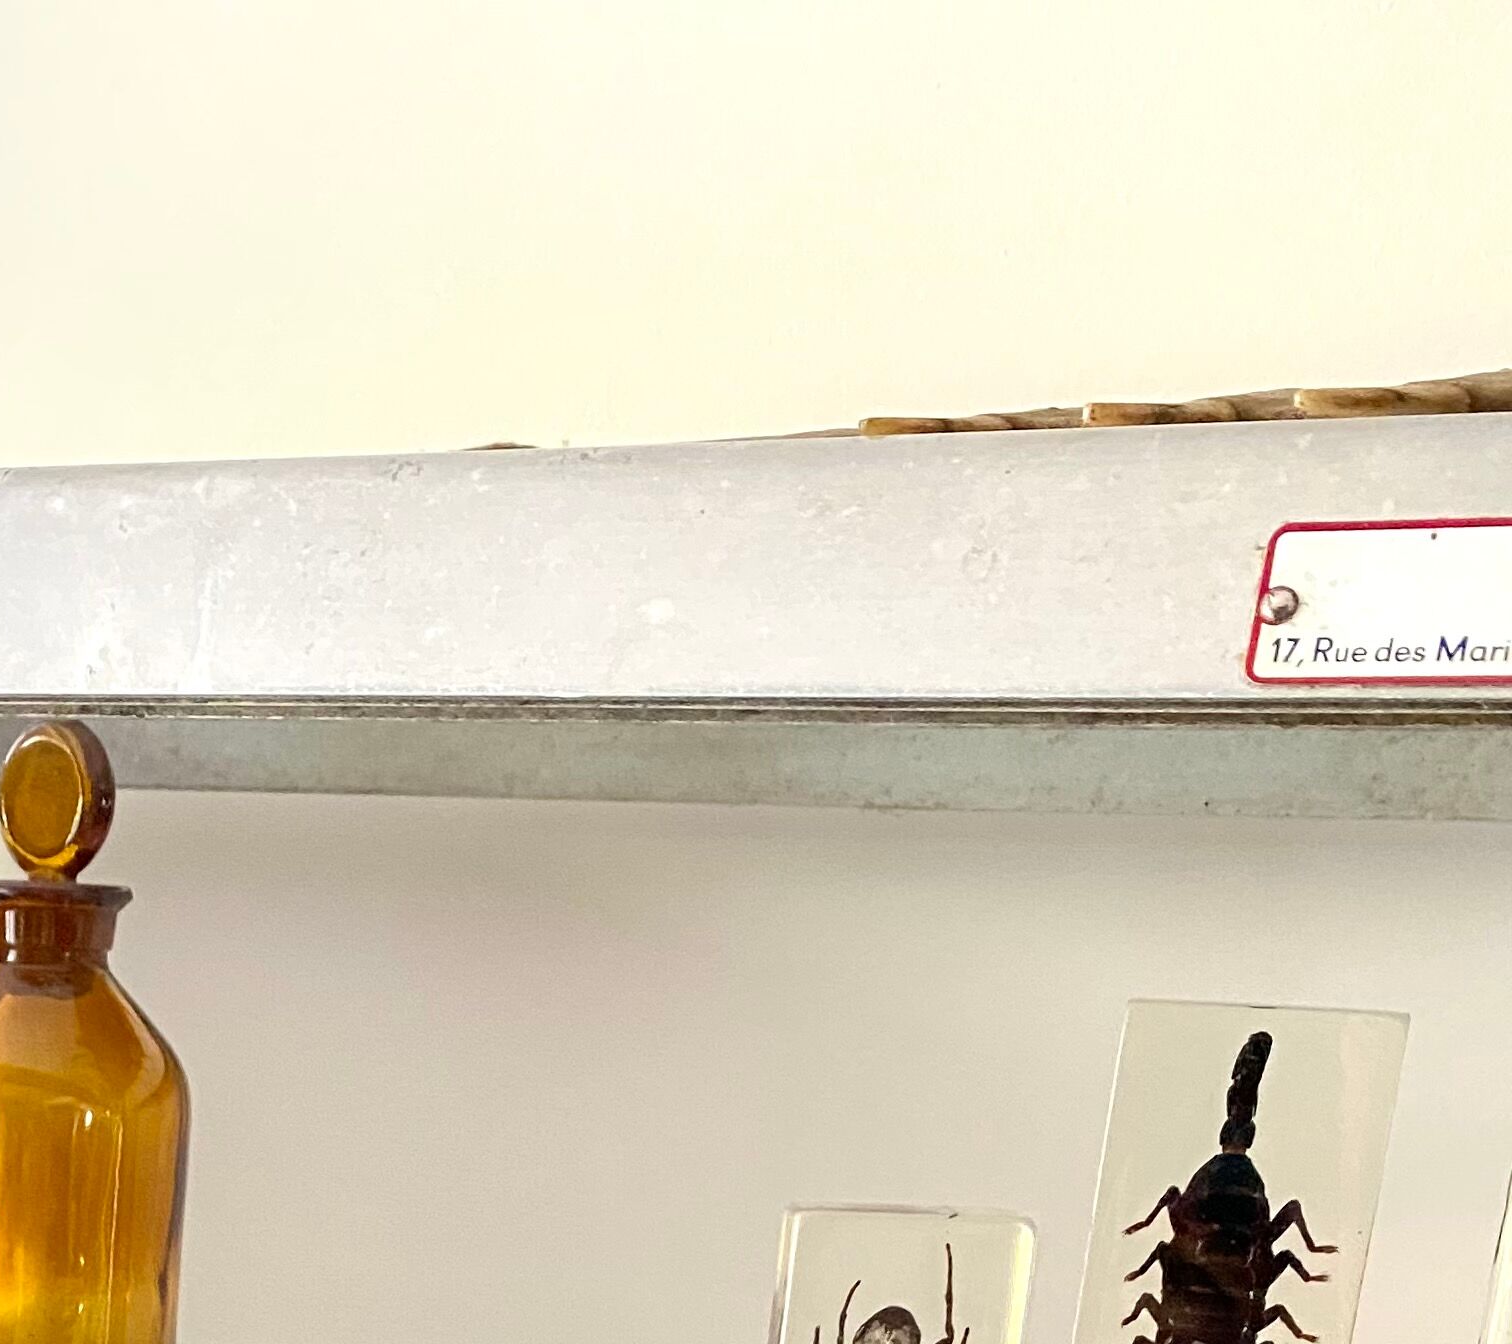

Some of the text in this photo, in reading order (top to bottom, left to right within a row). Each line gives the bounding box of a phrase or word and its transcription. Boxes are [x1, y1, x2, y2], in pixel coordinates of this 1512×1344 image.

[1271, 635, 1511, 667] 17, Rue des Mari
